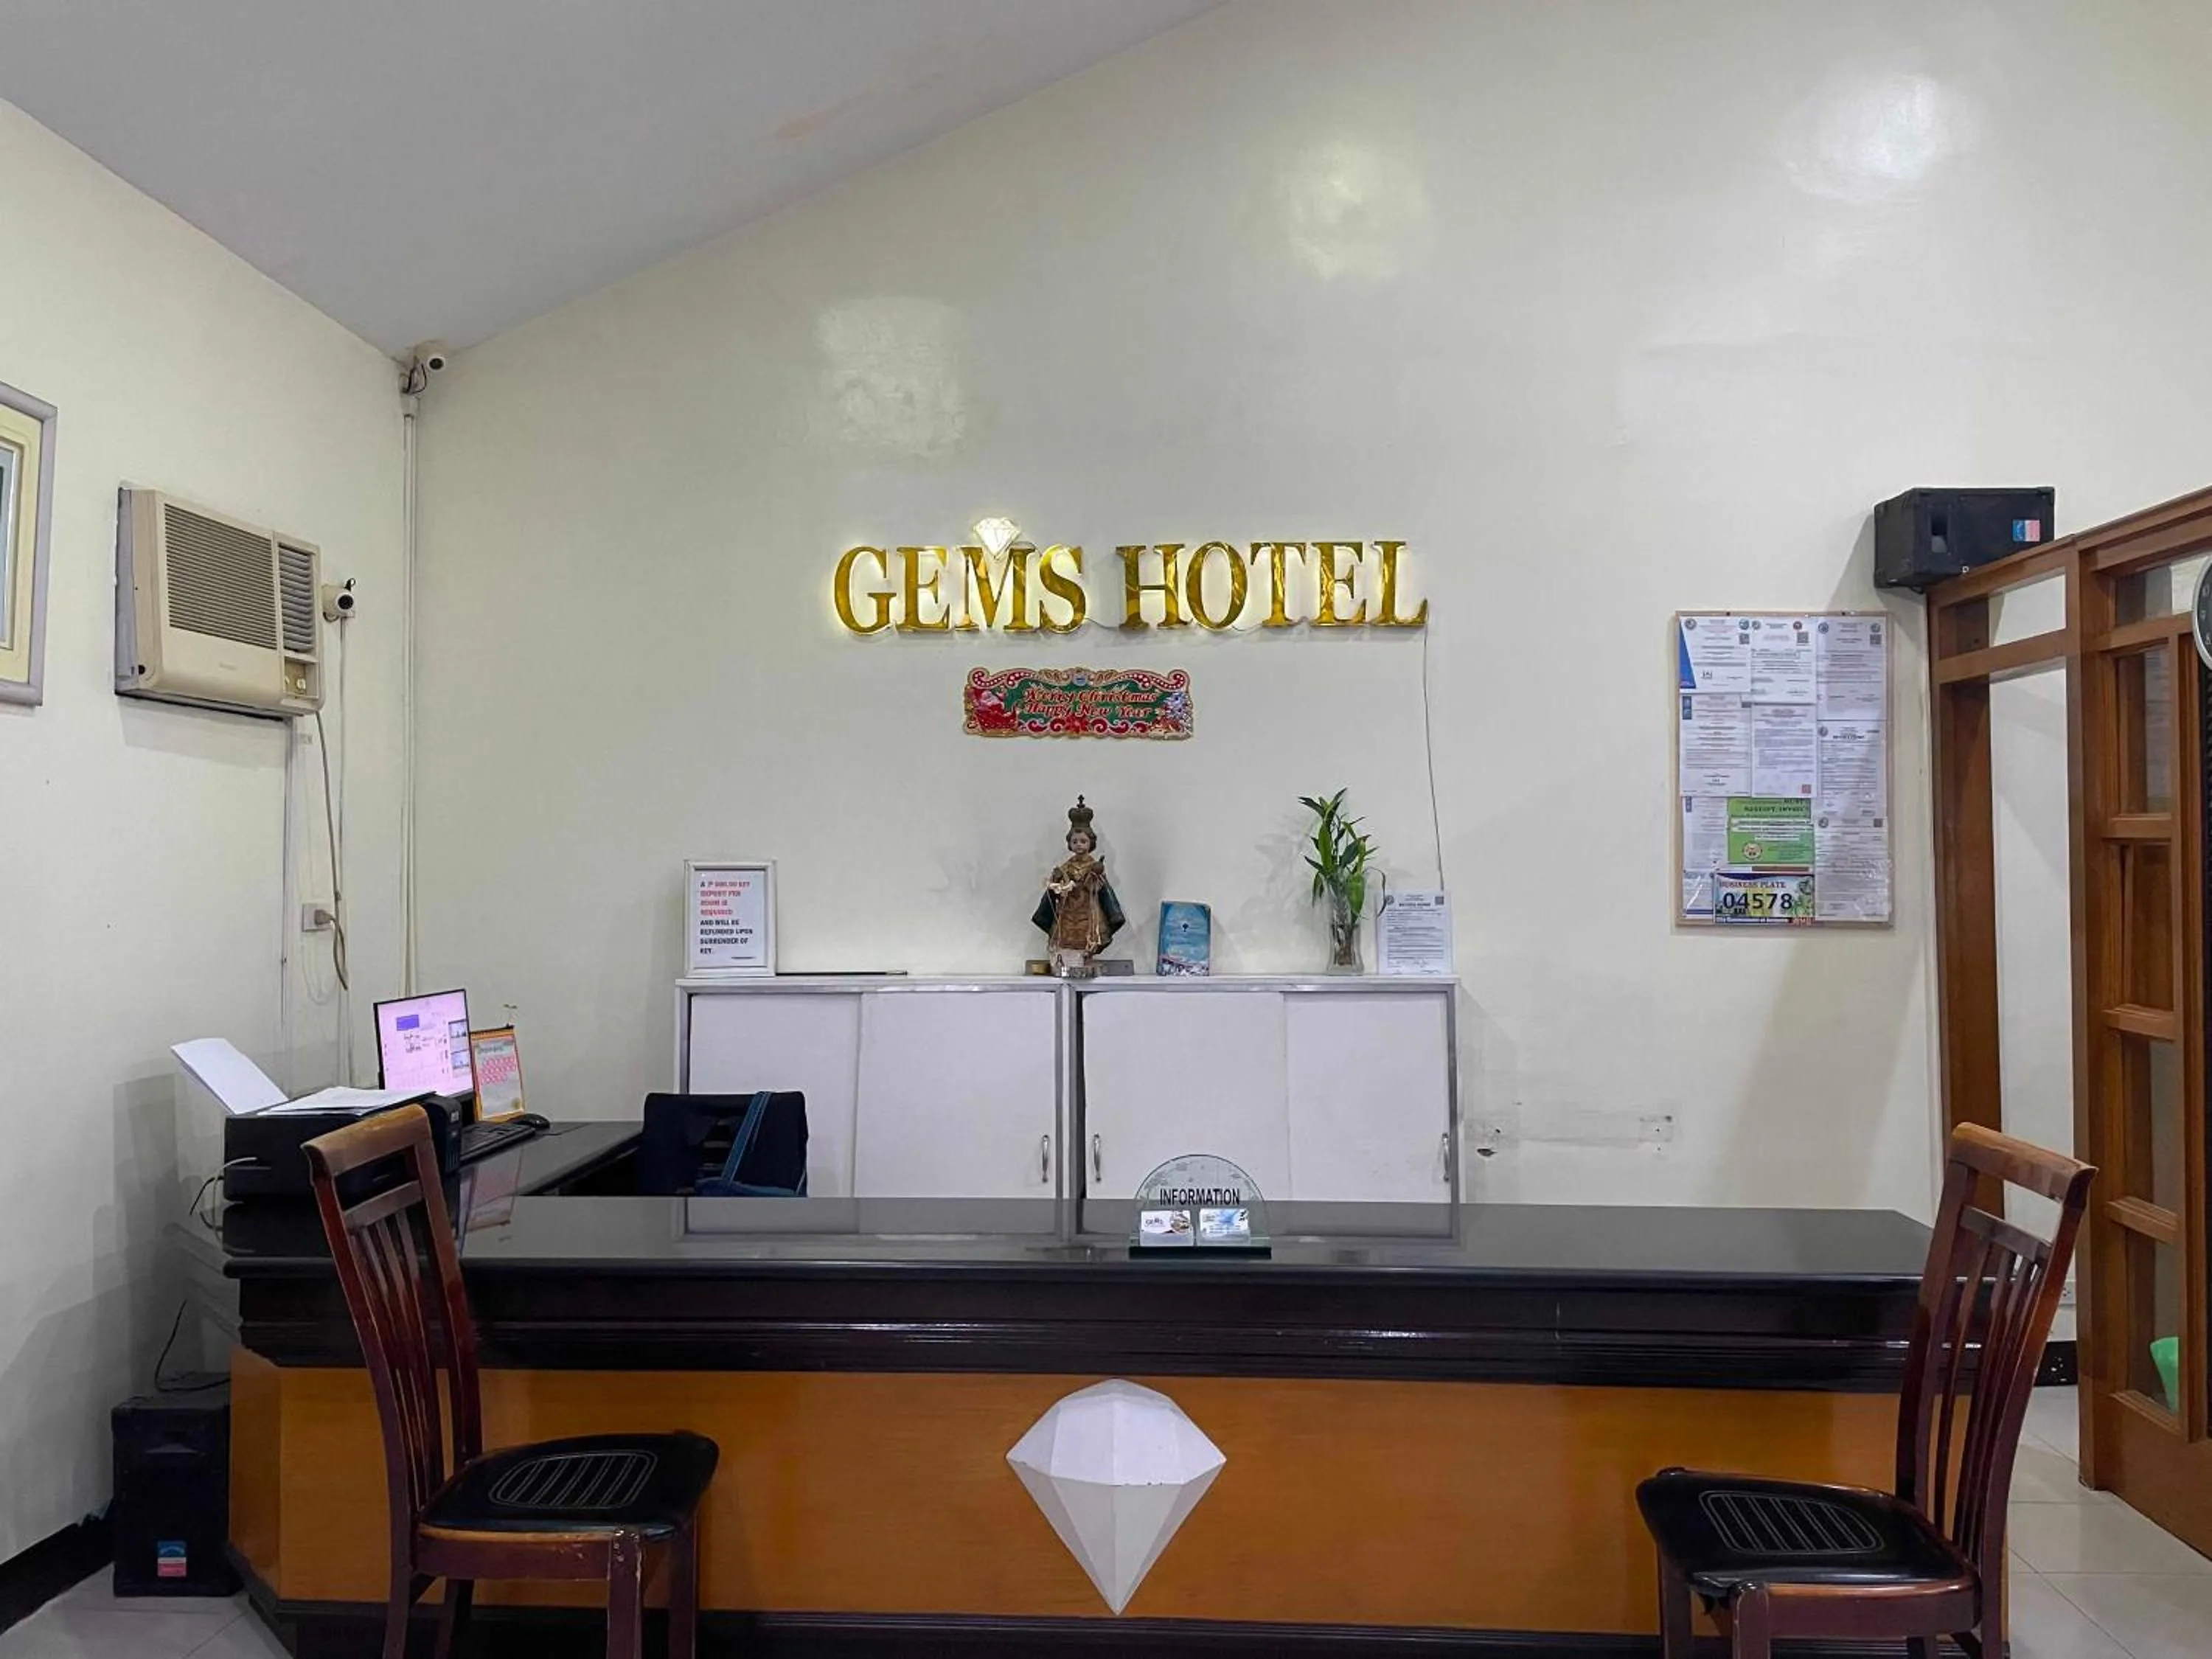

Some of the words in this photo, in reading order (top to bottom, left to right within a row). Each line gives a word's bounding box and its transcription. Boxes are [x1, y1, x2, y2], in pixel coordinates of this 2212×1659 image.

[833, 544, 1088, 635] GEMS
[1116, 540, 1429, 633] HOTEL
[1024, 689, 1073, 703] Merry
[1078, 688, 1157, 702] Christmas
[1025, 703, 1072, 717] Happy
[1077, 703, 1113, 716] New
[1117, 706, 1152, 717] Year
[1722, 892, 1793, 909] 04578
[1160, 1188, 1240, 1206] INFORMATION
